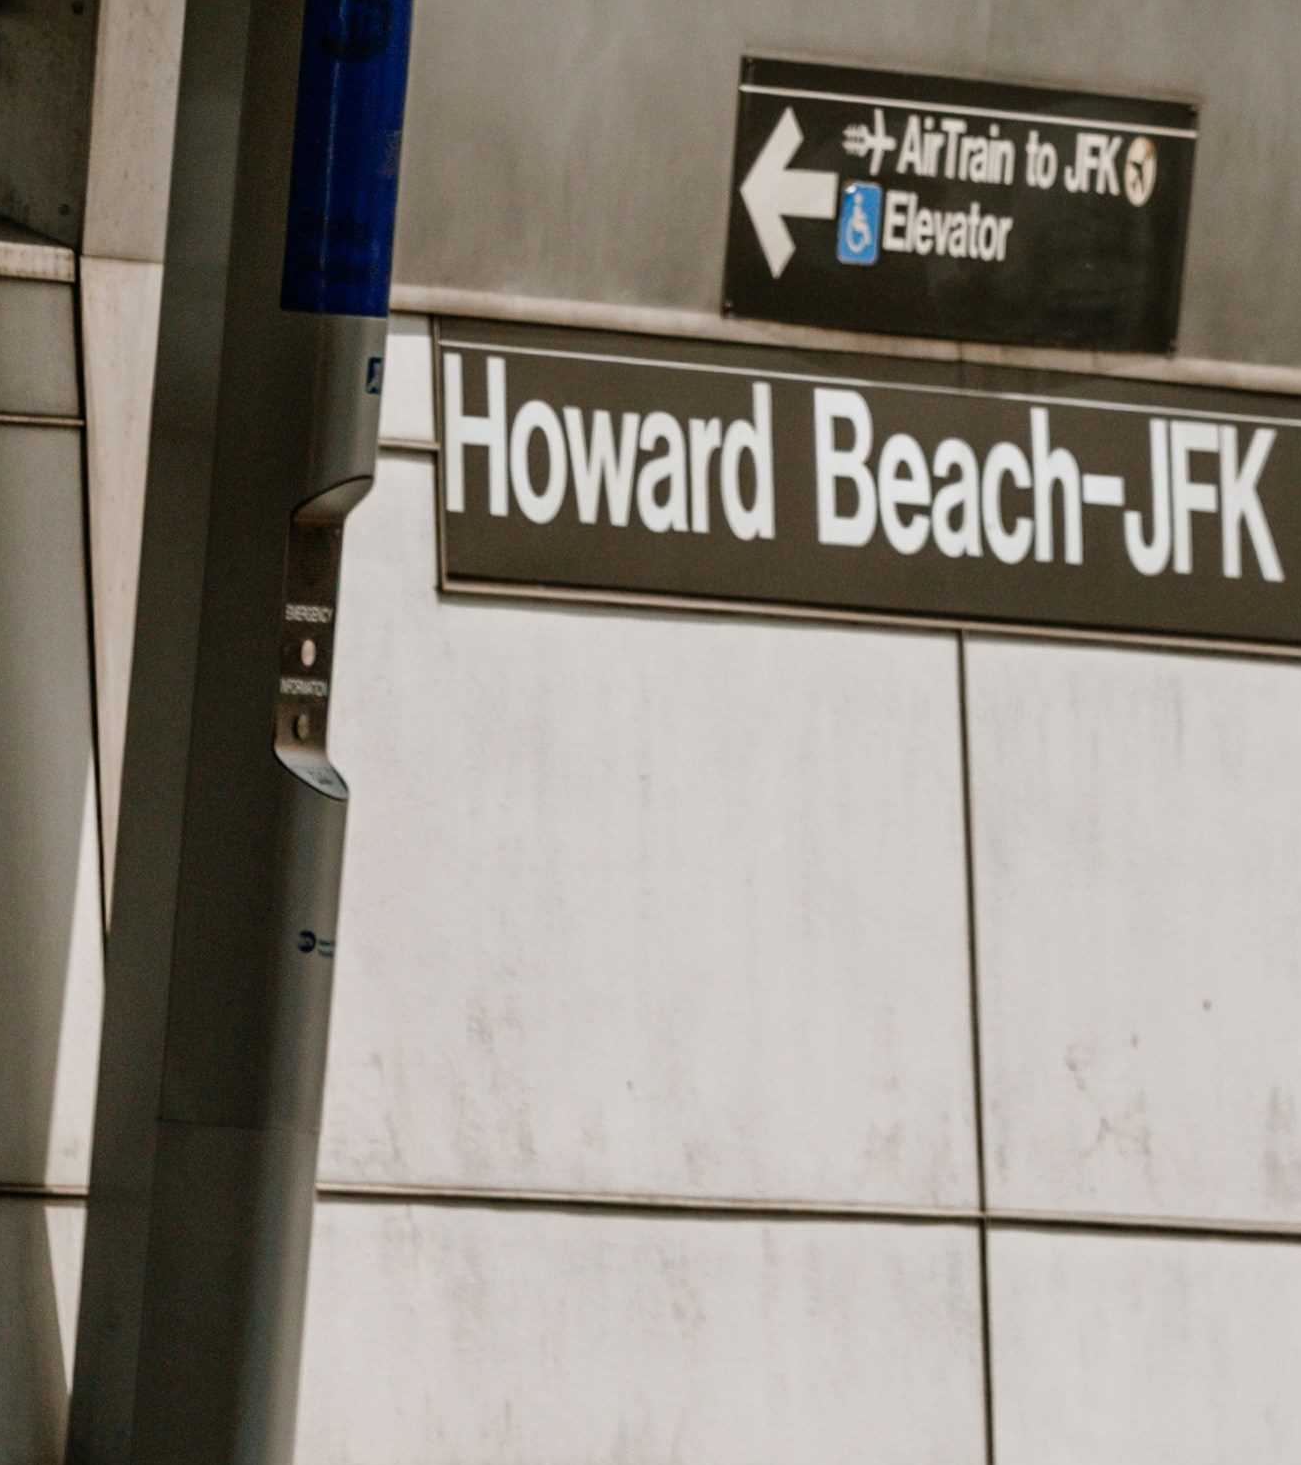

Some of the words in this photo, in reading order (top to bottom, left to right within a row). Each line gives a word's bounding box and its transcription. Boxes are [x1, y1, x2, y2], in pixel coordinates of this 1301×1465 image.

[895, 114, 1016, 186] AirTrain
[1025, 129, 1059, 190] to
[1064, 132, 1124, 197] JFK
[881, 189, 1015, 262] Elevator
[443, 352, 775, 541] Howard
[813, 387, 1285, 582] Beach-JFK
[285, 603, 334, 625] EMERGENCY
[279, 676, 329, 699] INFORMATION
